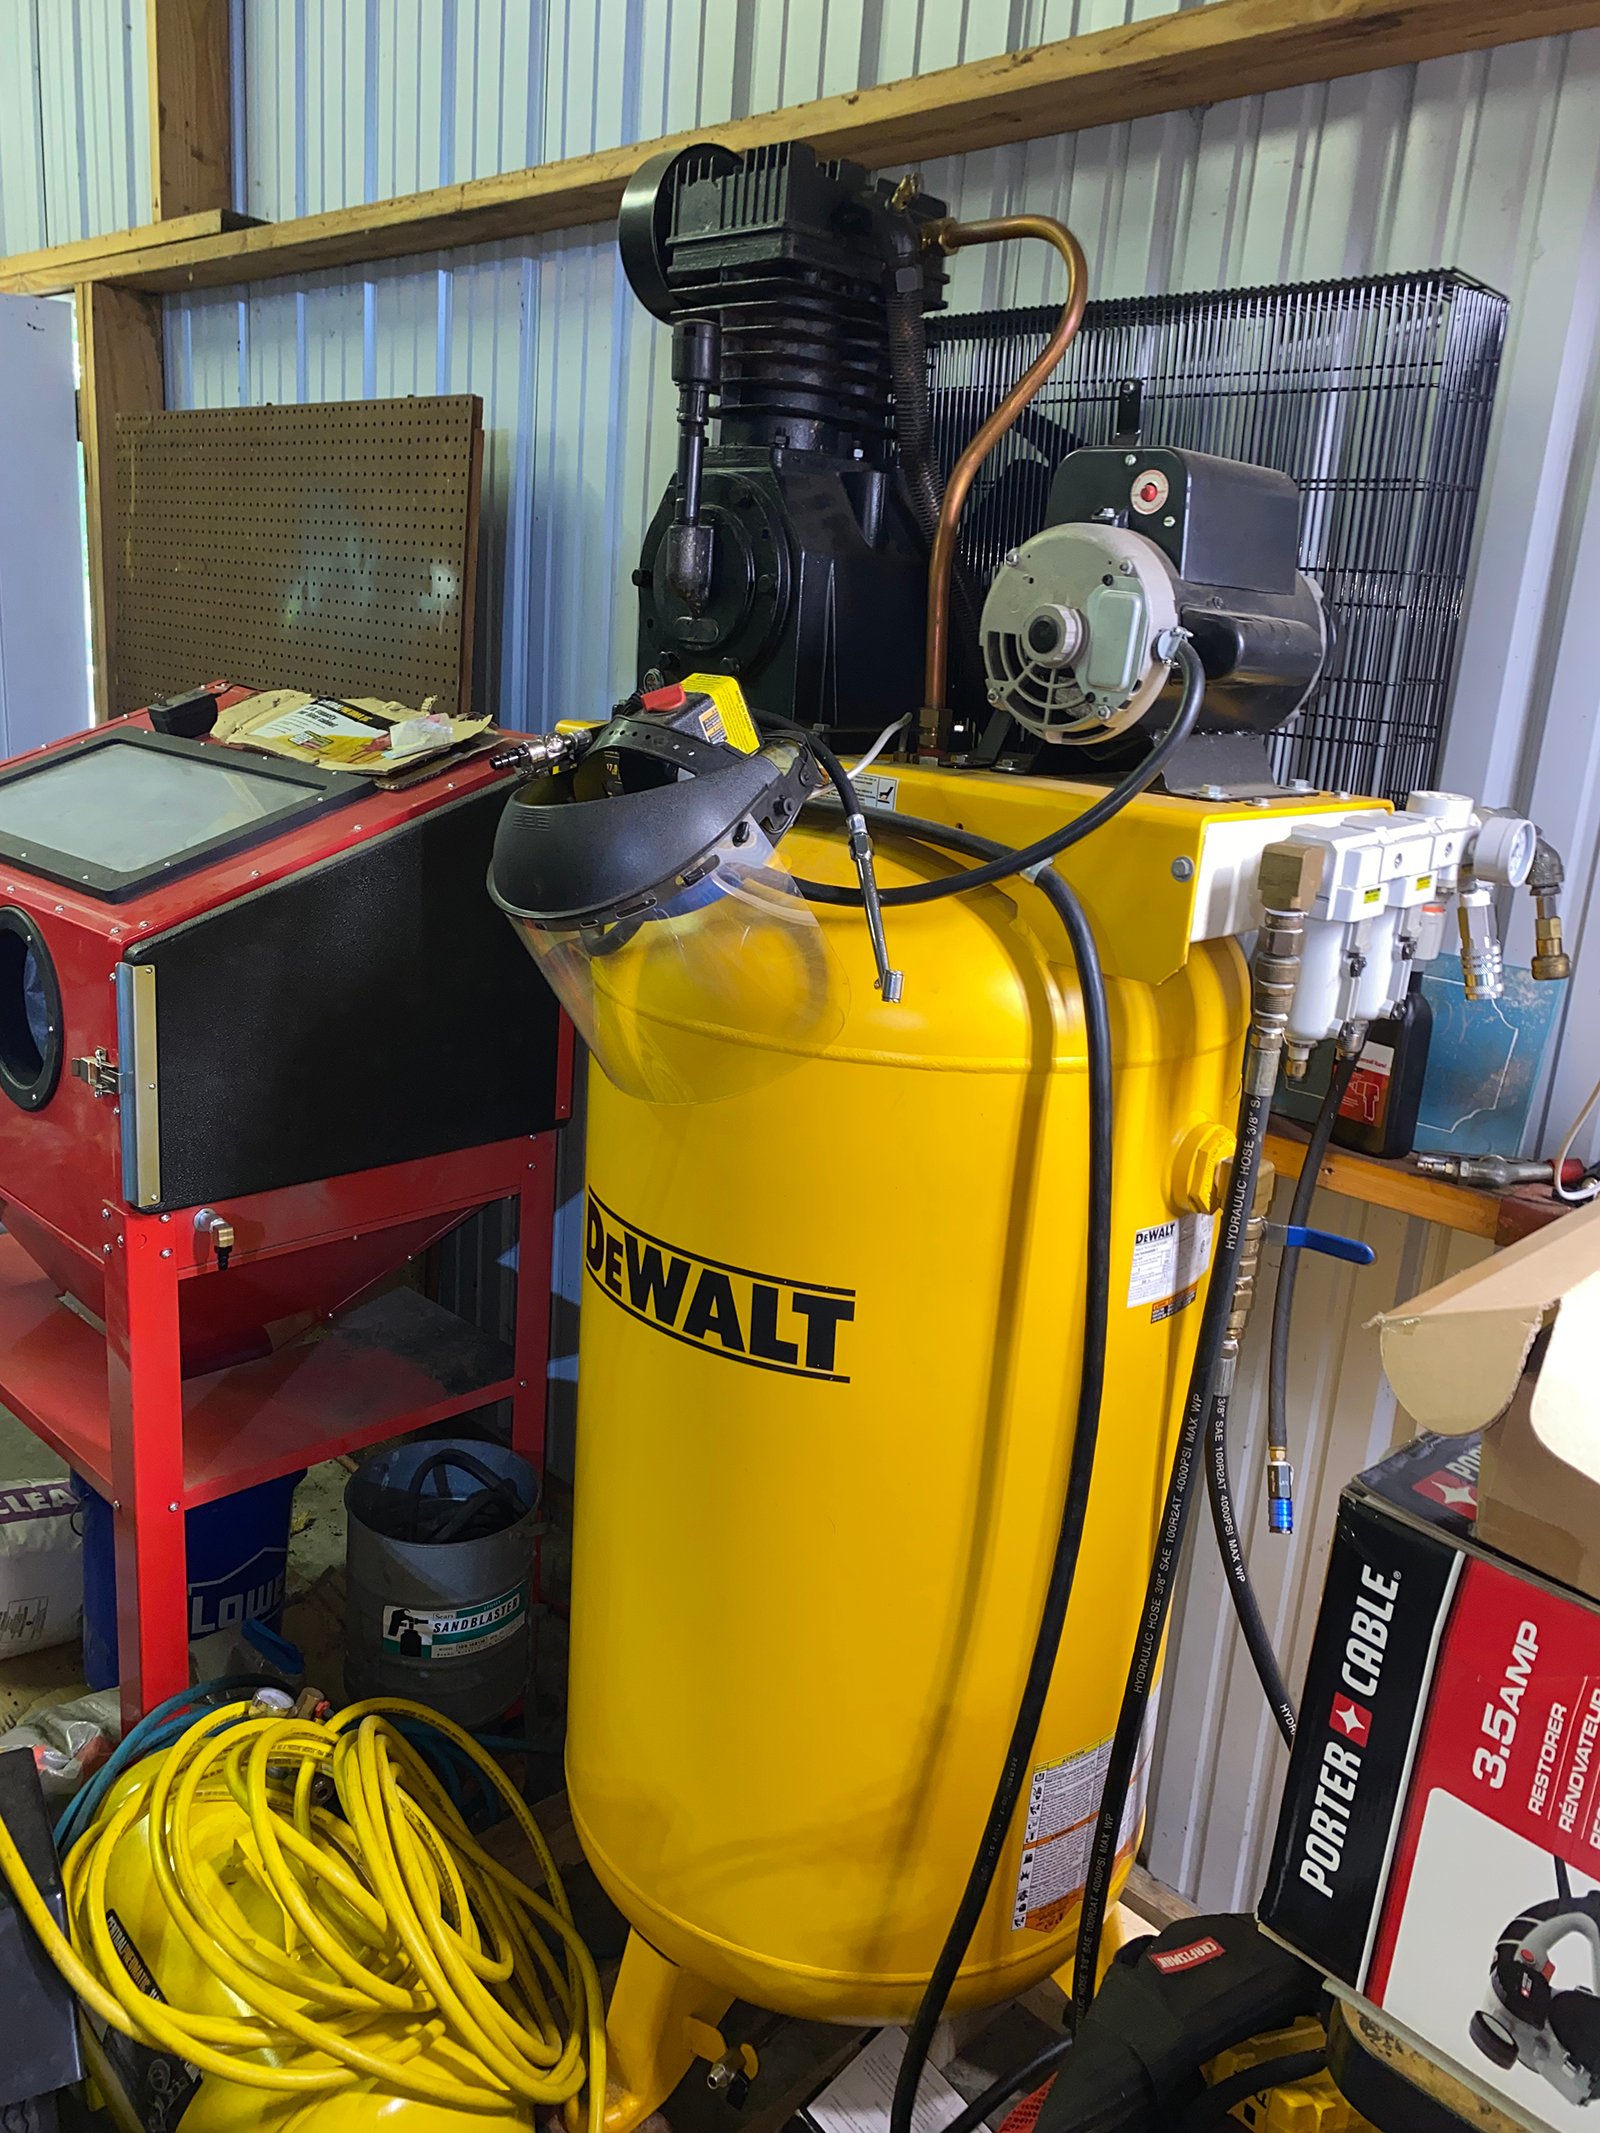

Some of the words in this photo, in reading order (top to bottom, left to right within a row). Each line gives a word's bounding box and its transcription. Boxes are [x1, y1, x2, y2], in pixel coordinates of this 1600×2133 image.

[1225, 1180, 1248, 1250] HYDRAULIC
[1240, 1140, 1255, 1175] HOSE
[1251, 1096, 1261, 1109] S
[1191, 1393, 1203, 1413] WP
[1185, 1417, 1199, 1443] MAX
[1214, 1420, 1225, 1442] SAE
[1176, 1446, 1193, 1493] 4000PSI
[1214, 1447, 1227, 1490] 100R2AT
[1165, 1495, 1183, 1543] 100R2AT
[1219, 1494, 1236, 1537] 4000PSI
[1160, 1548, 1172, 1572] SAE
[1228, 1539, 1241, 1563] MAX
[1235, 1564, 1247, 1583] WP
[433, 1597, 518, 1633] SANDBLASTER
[1147, 1598, 1162, 1630] HOSE
[1134, 1632, 1154, 1694] HYDRAULIC
[1527, 1702, 1568, 1816] RESTORER
[1558, 1688, 1600, 1833] RÉNOVATEUR
[1103, 1813, 1114, 1830] WP
[1299, 1741, 1362, 1899] PORTER
[1099, 1833, 1111, 1854] MAX
[1093, 1858, 1106, 1894] 4000PSI
